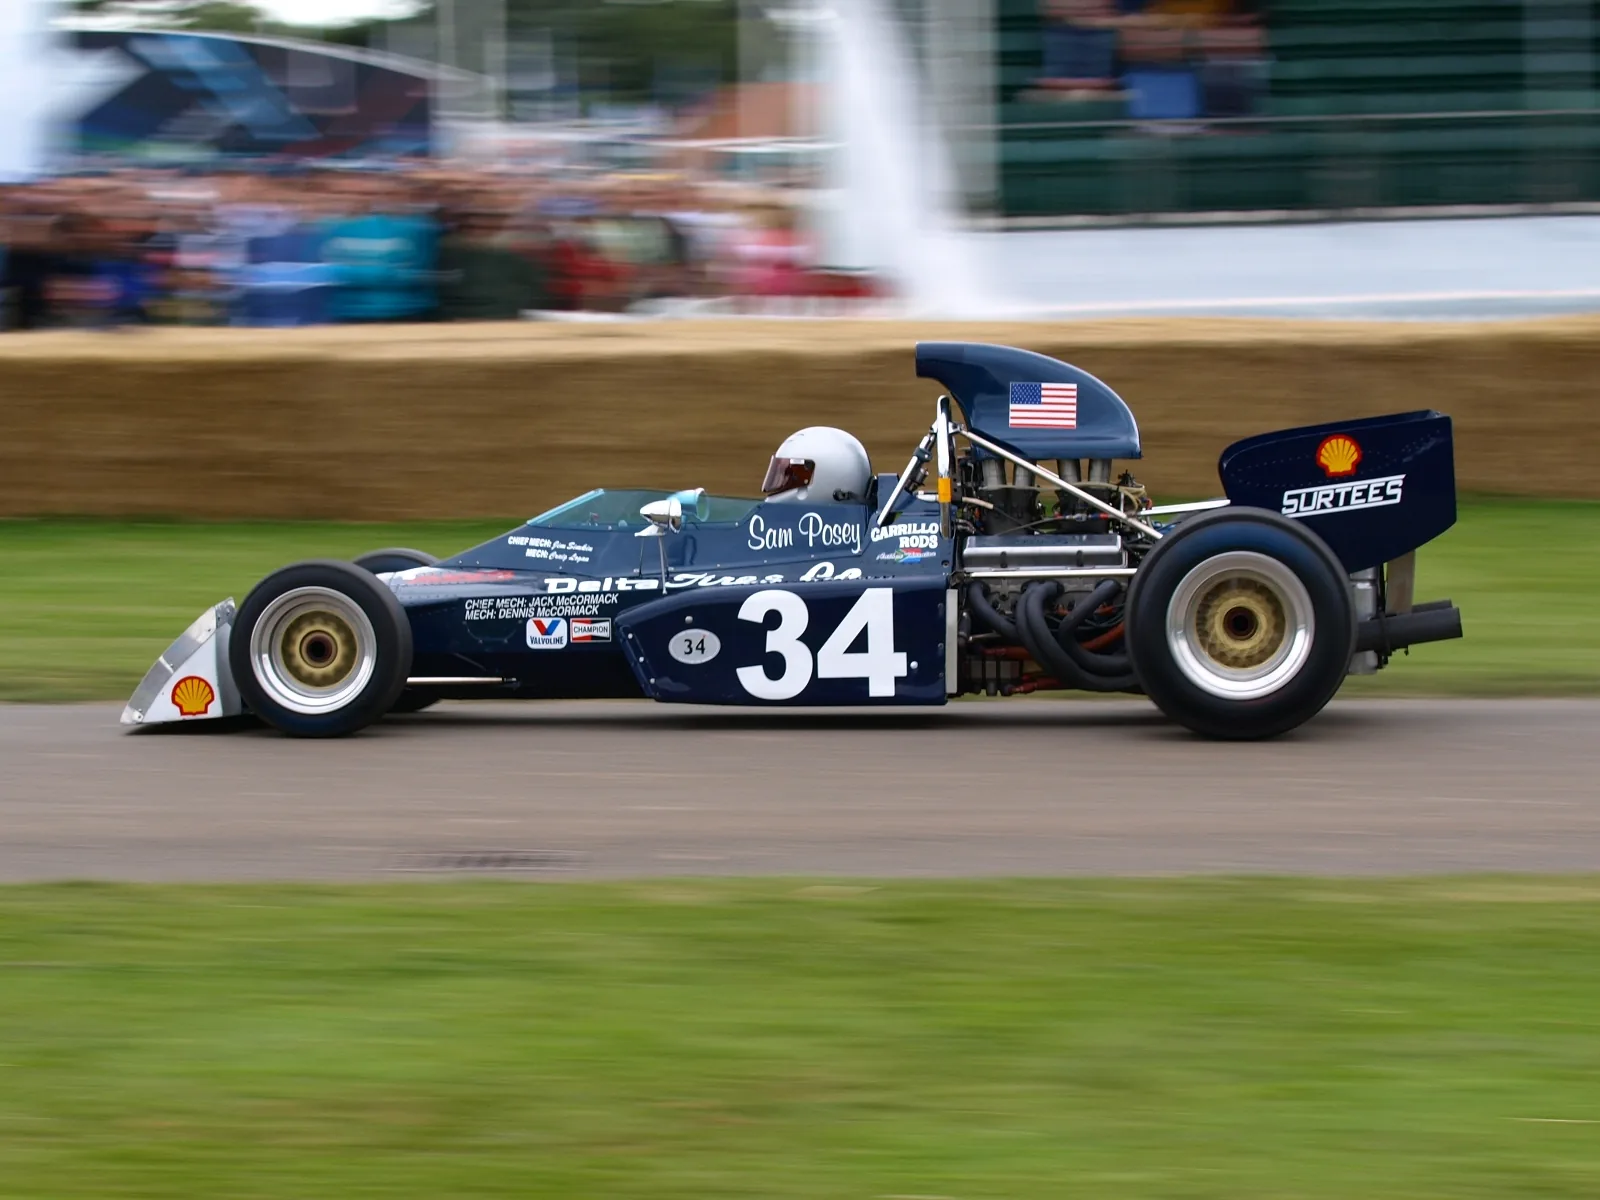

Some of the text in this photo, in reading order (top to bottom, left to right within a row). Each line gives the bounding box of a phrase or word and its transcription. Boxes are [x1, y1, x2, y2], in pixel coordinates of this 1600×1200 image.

[1281, 474, 1406, 518] SURTEES
[748, 512, 861, 554] Sam Posey
[871, 522, 939, 542] CARRILLO
[508, 536, 529, 546] CHIEF
[529, 537, 552, 548] MECH:
[899, 535, 938, 549] RODS
[526, 548, 548, 558] MECH:
[544, 577, 659, 593] Delta
[465, 593, 619, 609] CHIEF MECH: JACK McCORMACK
[465, 604, 599, 620] MECH: DENNIS McCORMACK
[573, 625, 608, 634] CHAMPION
[530, 635, 564, 645] VALVOLINE
[684, 638, 706, 655] 34
[736, 587, 908, 700] 34
